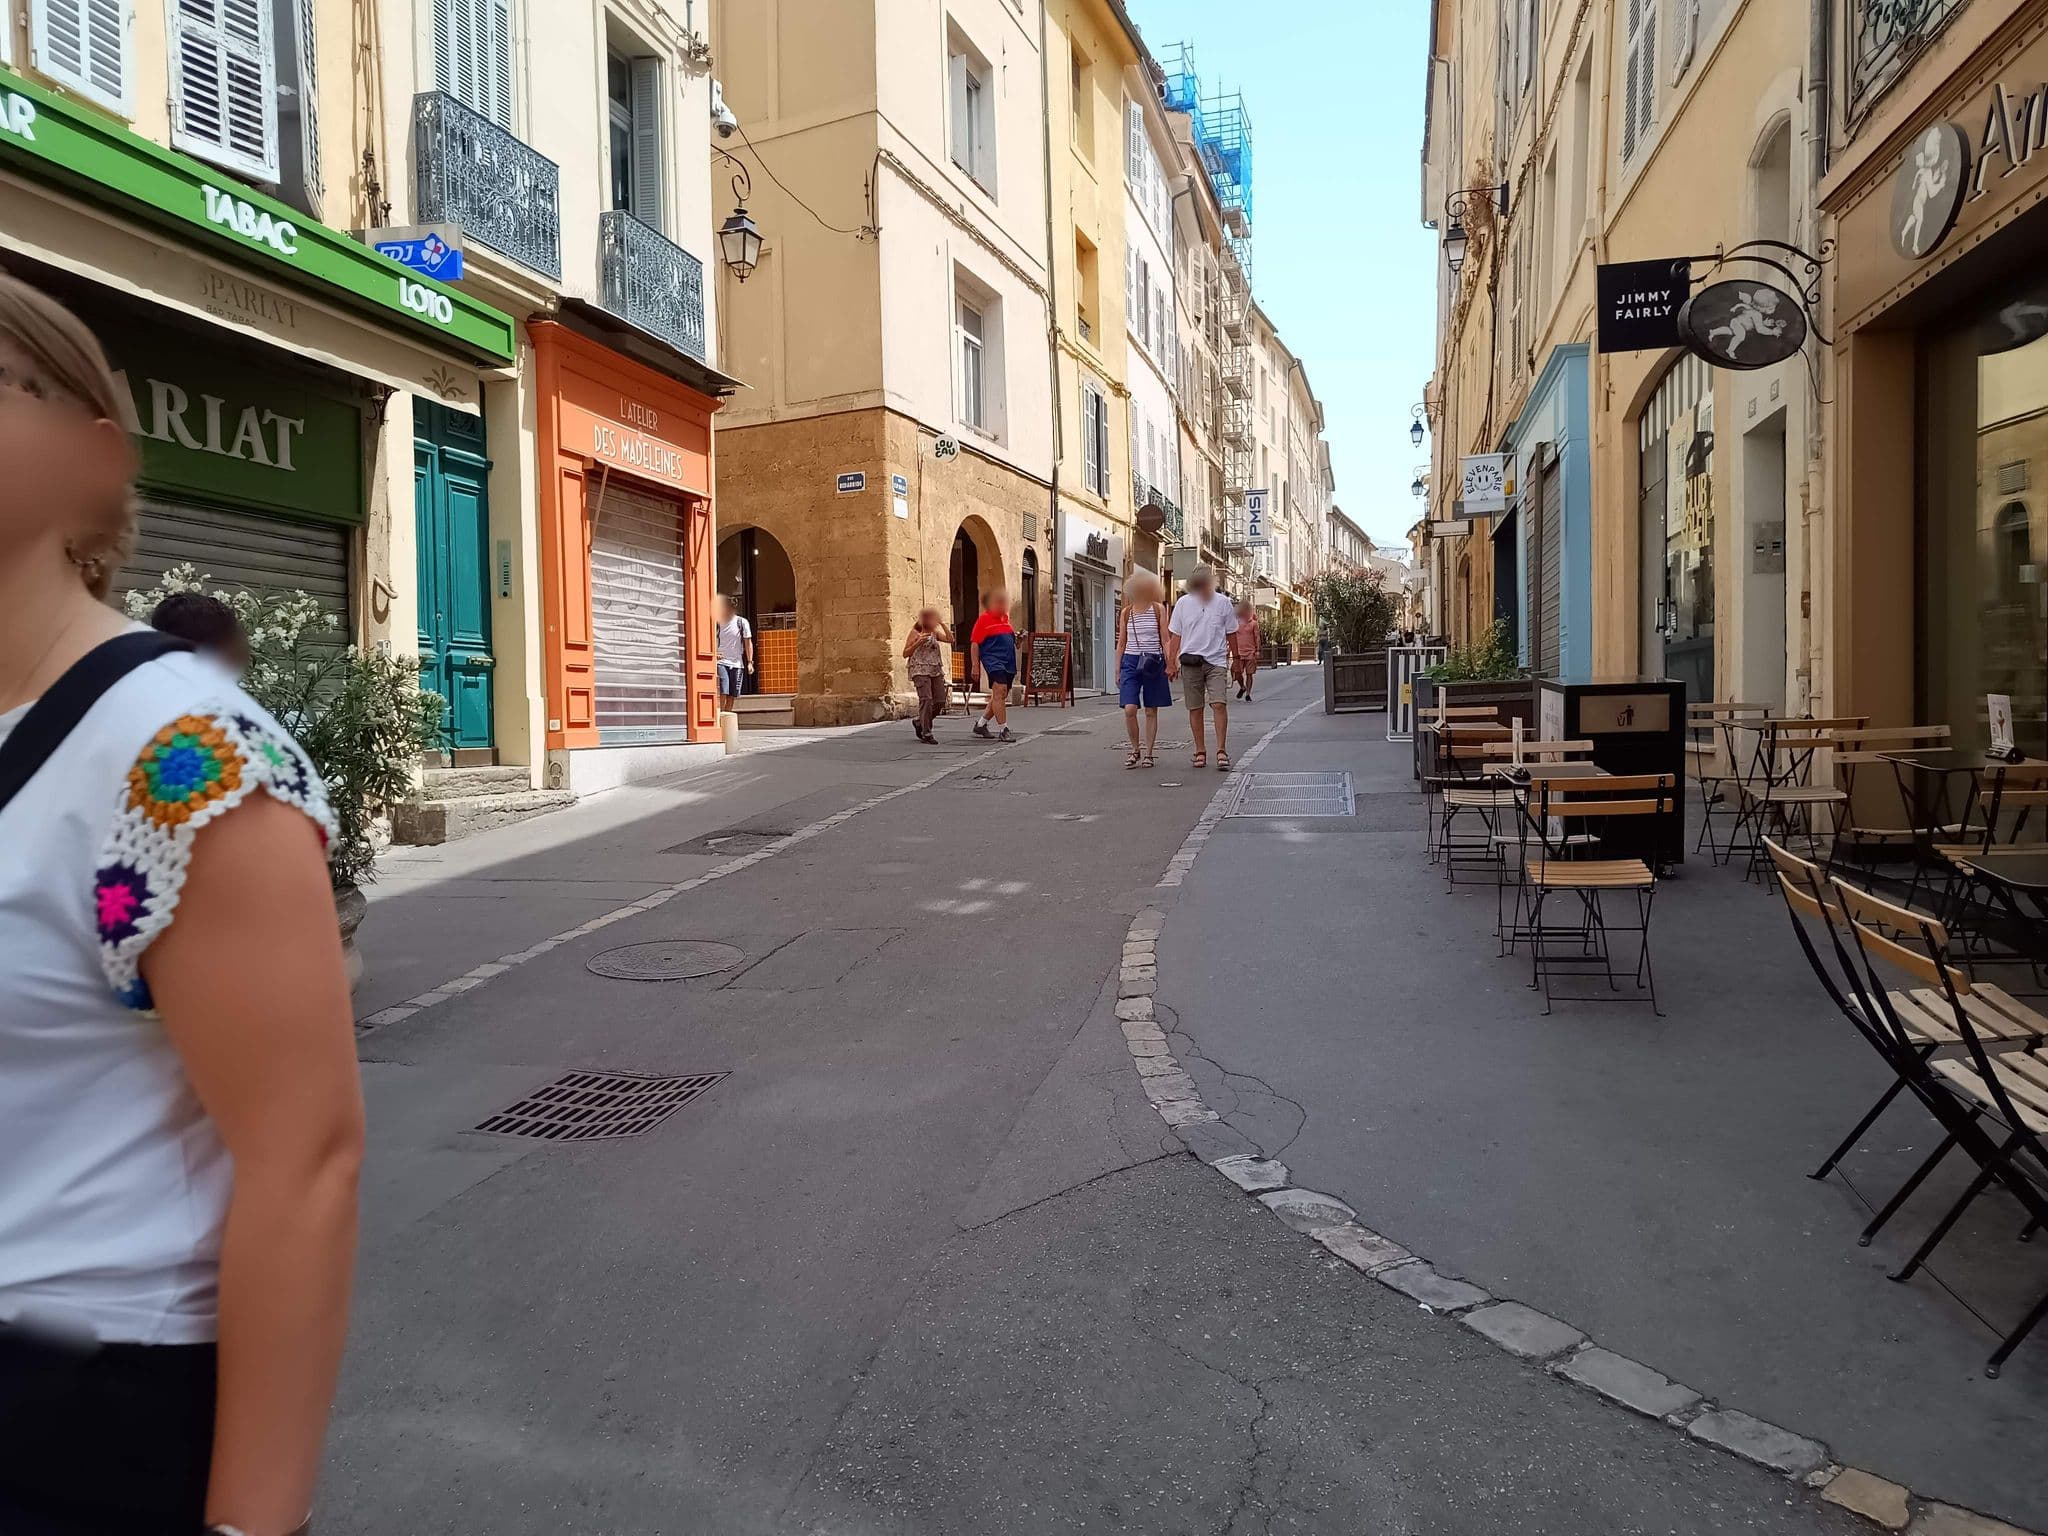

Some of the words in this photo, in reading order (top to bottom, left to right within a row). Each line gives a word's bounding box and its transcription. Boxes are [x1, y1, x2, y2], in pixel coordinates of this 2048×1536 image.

[201, 184, 298, 255] TABAC
[398, 276, 454, 324] LOTO
[1615, 305, 1672, 320] FAIRLY
[1616, 289, 1671, 305] JIMMY
[620, 397, 658, 432] L'ATELIER
[594, 423, 617, 458] DES
[620, 435, 683, 480] MADELEINES
[1465, 464, 1503, 495] ELEVENPARIS
[1685, 471, 1708, 513] CLUB
[1249, 496, 1262, 537] PMS
